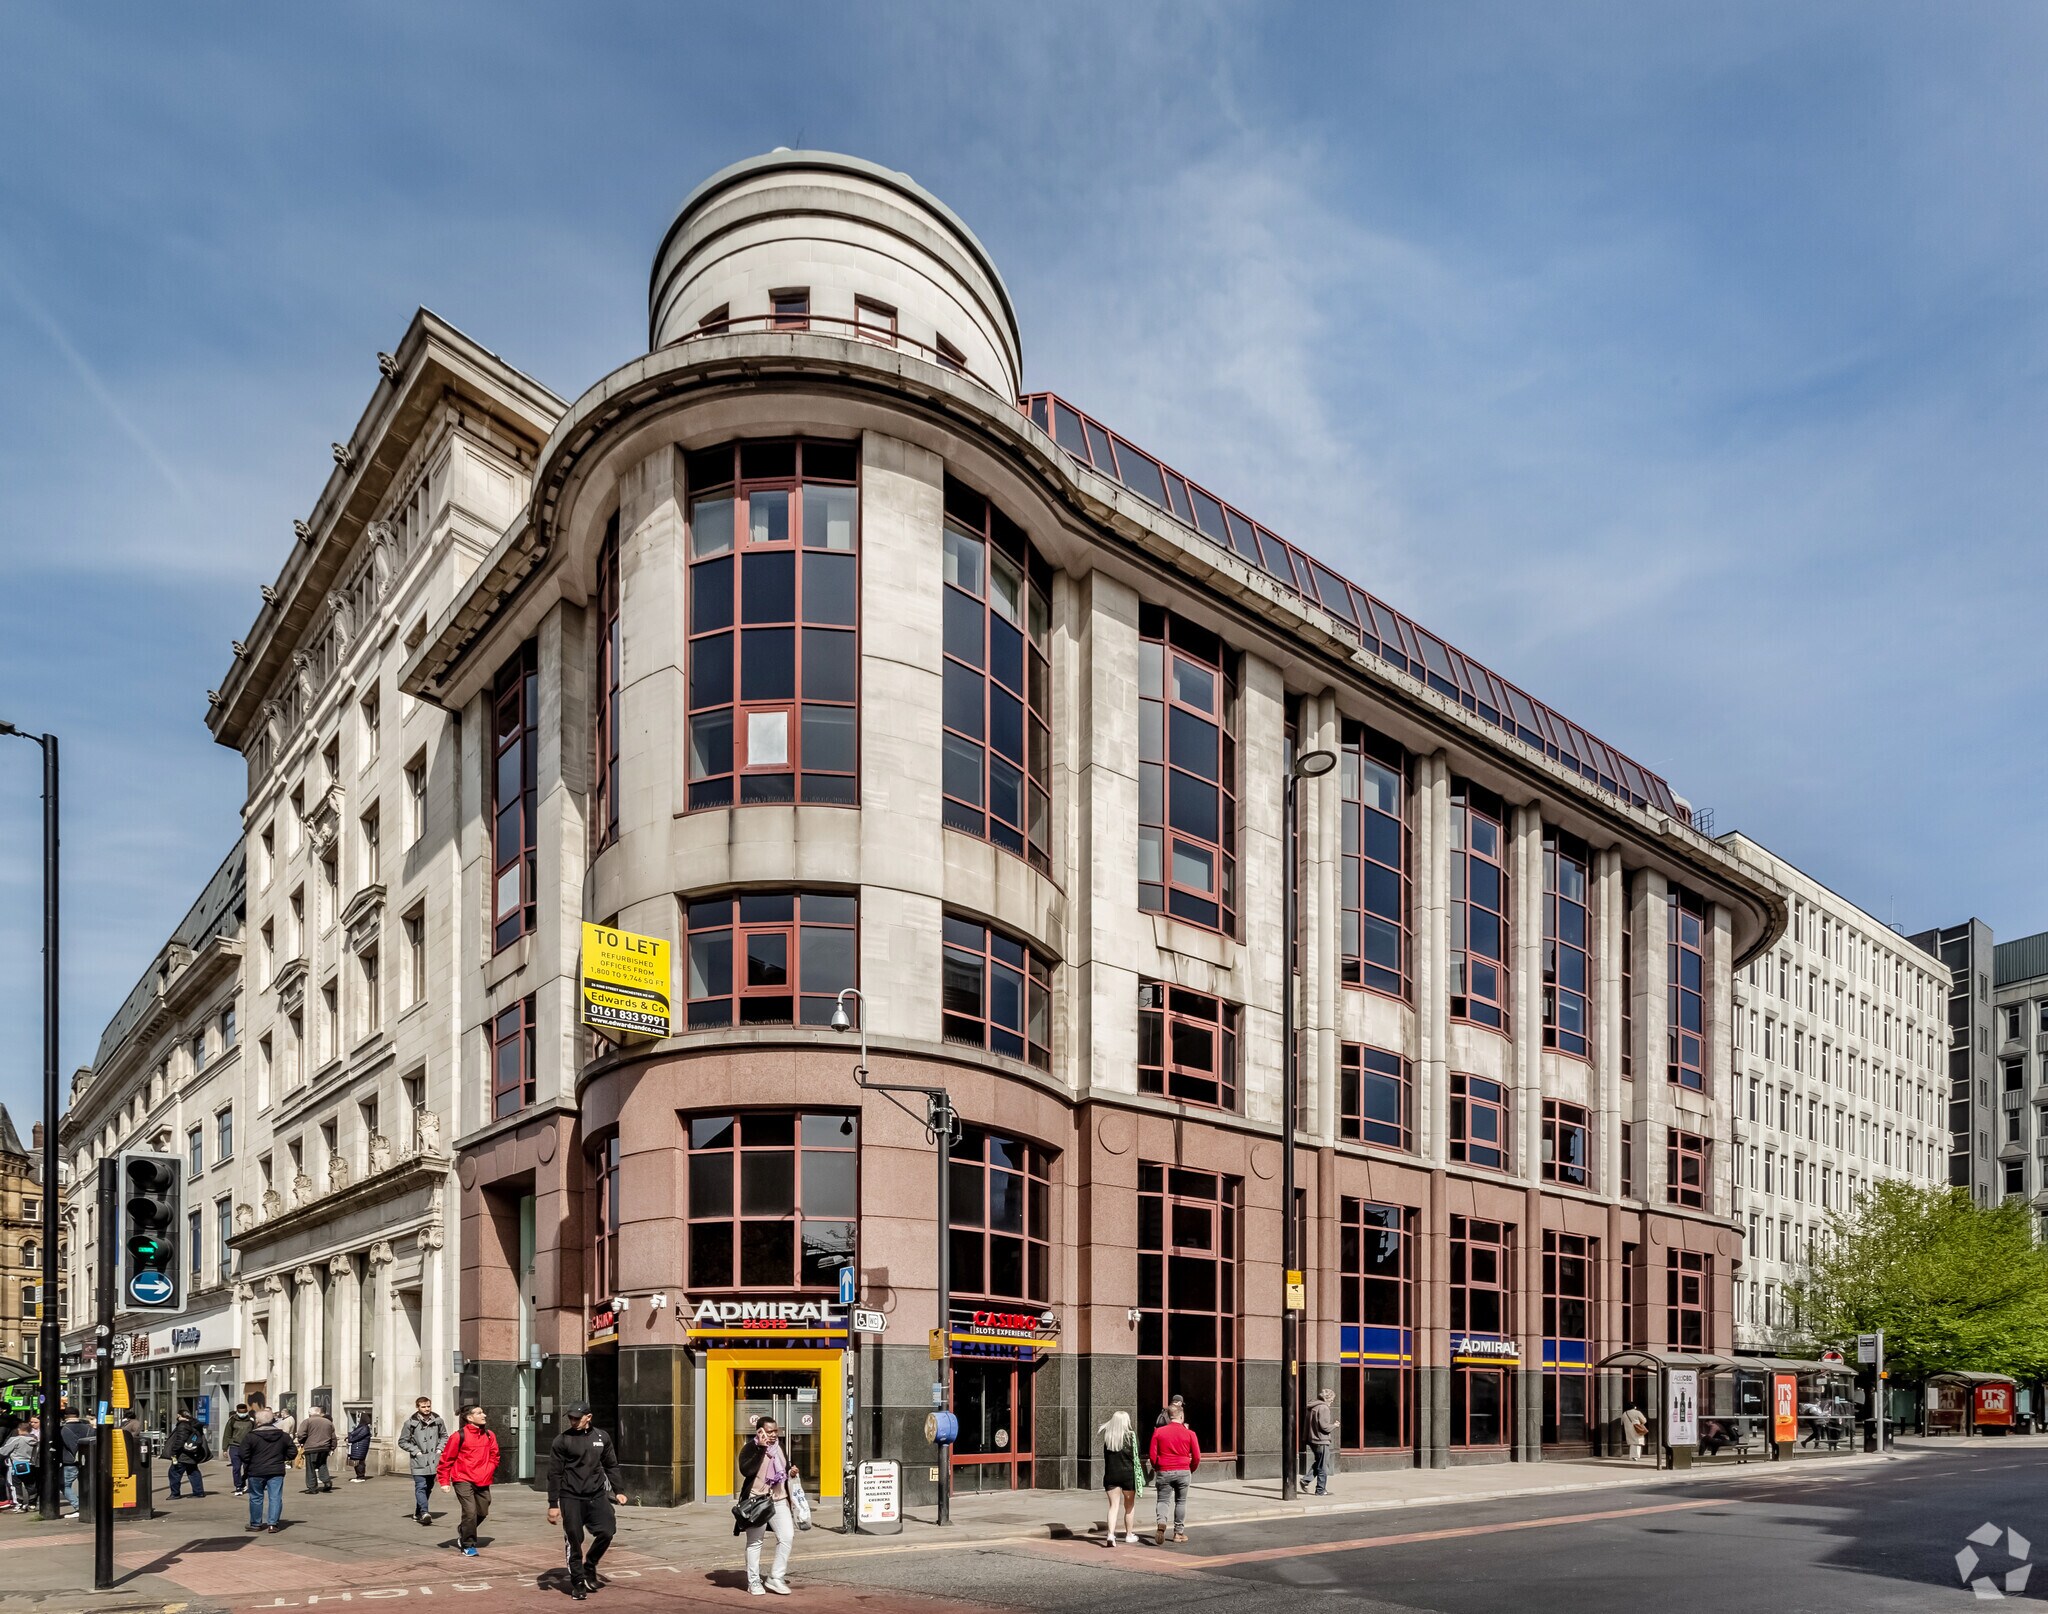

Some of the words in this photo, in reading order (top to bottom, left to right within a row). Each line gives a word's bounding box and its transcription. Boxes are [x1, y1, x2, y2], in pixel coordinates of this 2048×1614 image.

[594, 929, 618, 947] TO
[626, 936, 660, 956] LET
[600, 960, 632, 972] OFFICES
[634, 967, 654, 976] FROM
[601, 952, 654, 968] REFURBISHED
[590, 966, 610, 976] 1,800
[591, 992, 637, 1008] Edwards
[640, 1001, 648, 1010] &
[652, 1003, 664, 1013] Co
[590, 1004, 616, 1018] 0161
[619, 1010, 639, 1022] 833
[641, 1014, 665, 1026] 9991
[591, 1017, 665, 1034] www.edwardsandco.com
[693, 1300, 842, 1322] ADMIRAL
[743, 1318, 788, 1329] SLOTS
[973, 1310, 1037, 1330] CASINO
[976, 1327, 996, 1335] SLOTS
[996, 1328, 1032, 1338] EXPERIENCE
[1458, 1338, 1519, 1356] ADMIRAL
[1778, 1384, 1792, 1400] IT'S
[1982, 1389, 2006, 1400] IT'S
[1780, 1400, 1790, 1416] ON
[1984, 1400, 2004, 1410] ON
